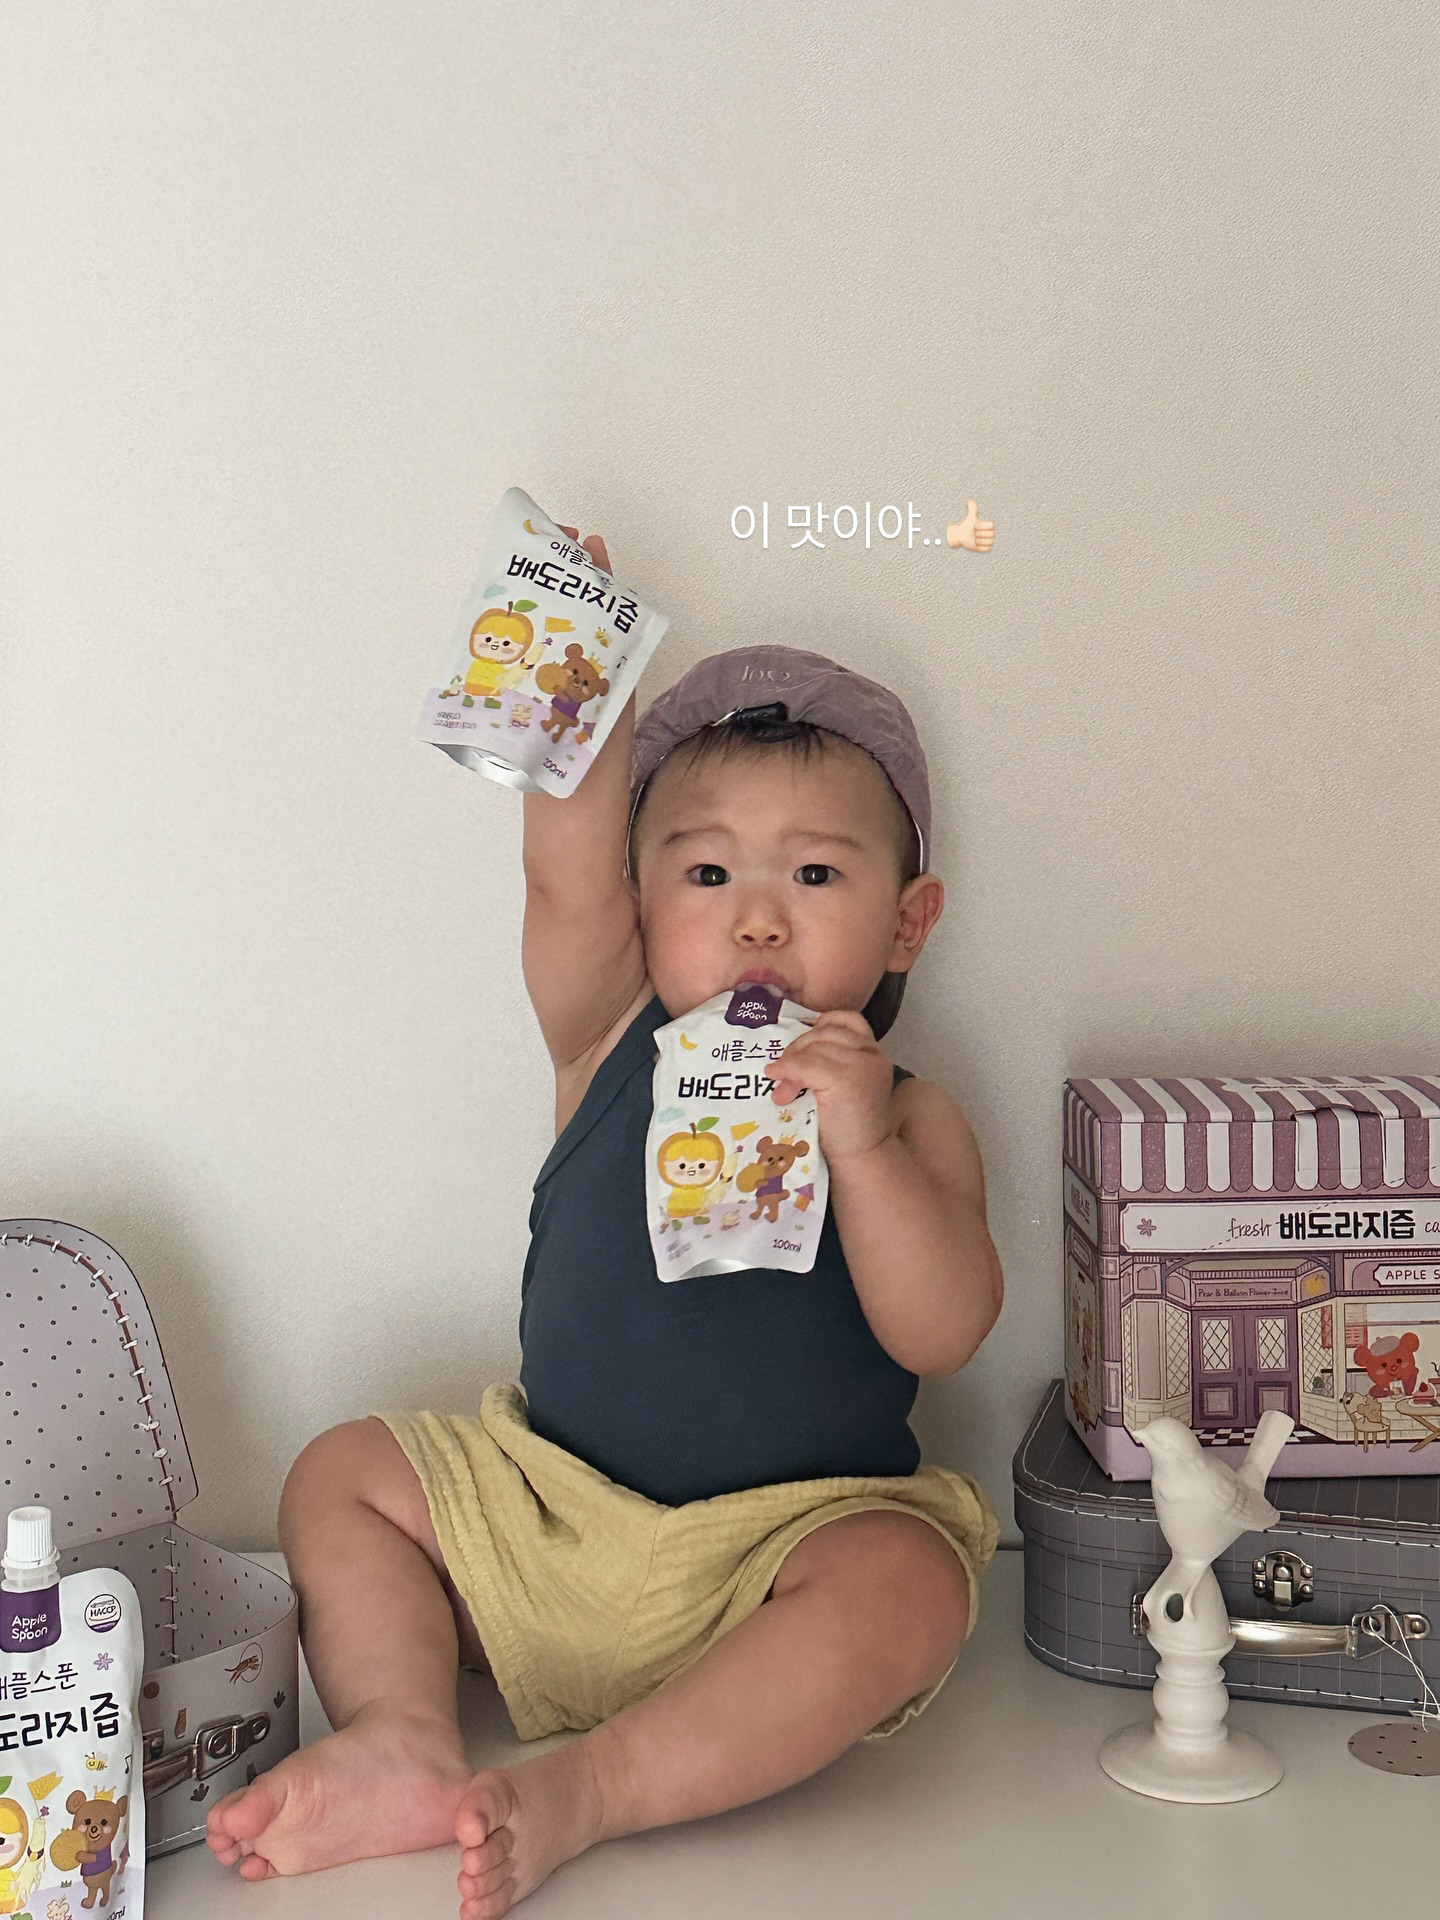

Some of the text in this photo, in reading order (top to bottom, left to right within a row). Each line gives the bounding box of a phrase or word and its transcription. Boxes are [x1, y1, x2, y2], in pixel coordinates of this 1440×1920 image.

[506, 554, 639, 633] 배도라지즙
[712, 1040, 784, 1062] 애플스푼
[678, 1072, 808, 1101] 배도라
[1228, 1217, 1272, 1238] fresh
[1279, 1210, 1416, 1240] 배도라지즙
[772, 1238, 803, 1253] 100ml
[1385, 1269, 1427, 1280] APPLE
[90, 1605, 117, 1617] HACCP
[12, 1613, 47, 1629] Apple
[12, 1626, 48, 1642] Spoon
